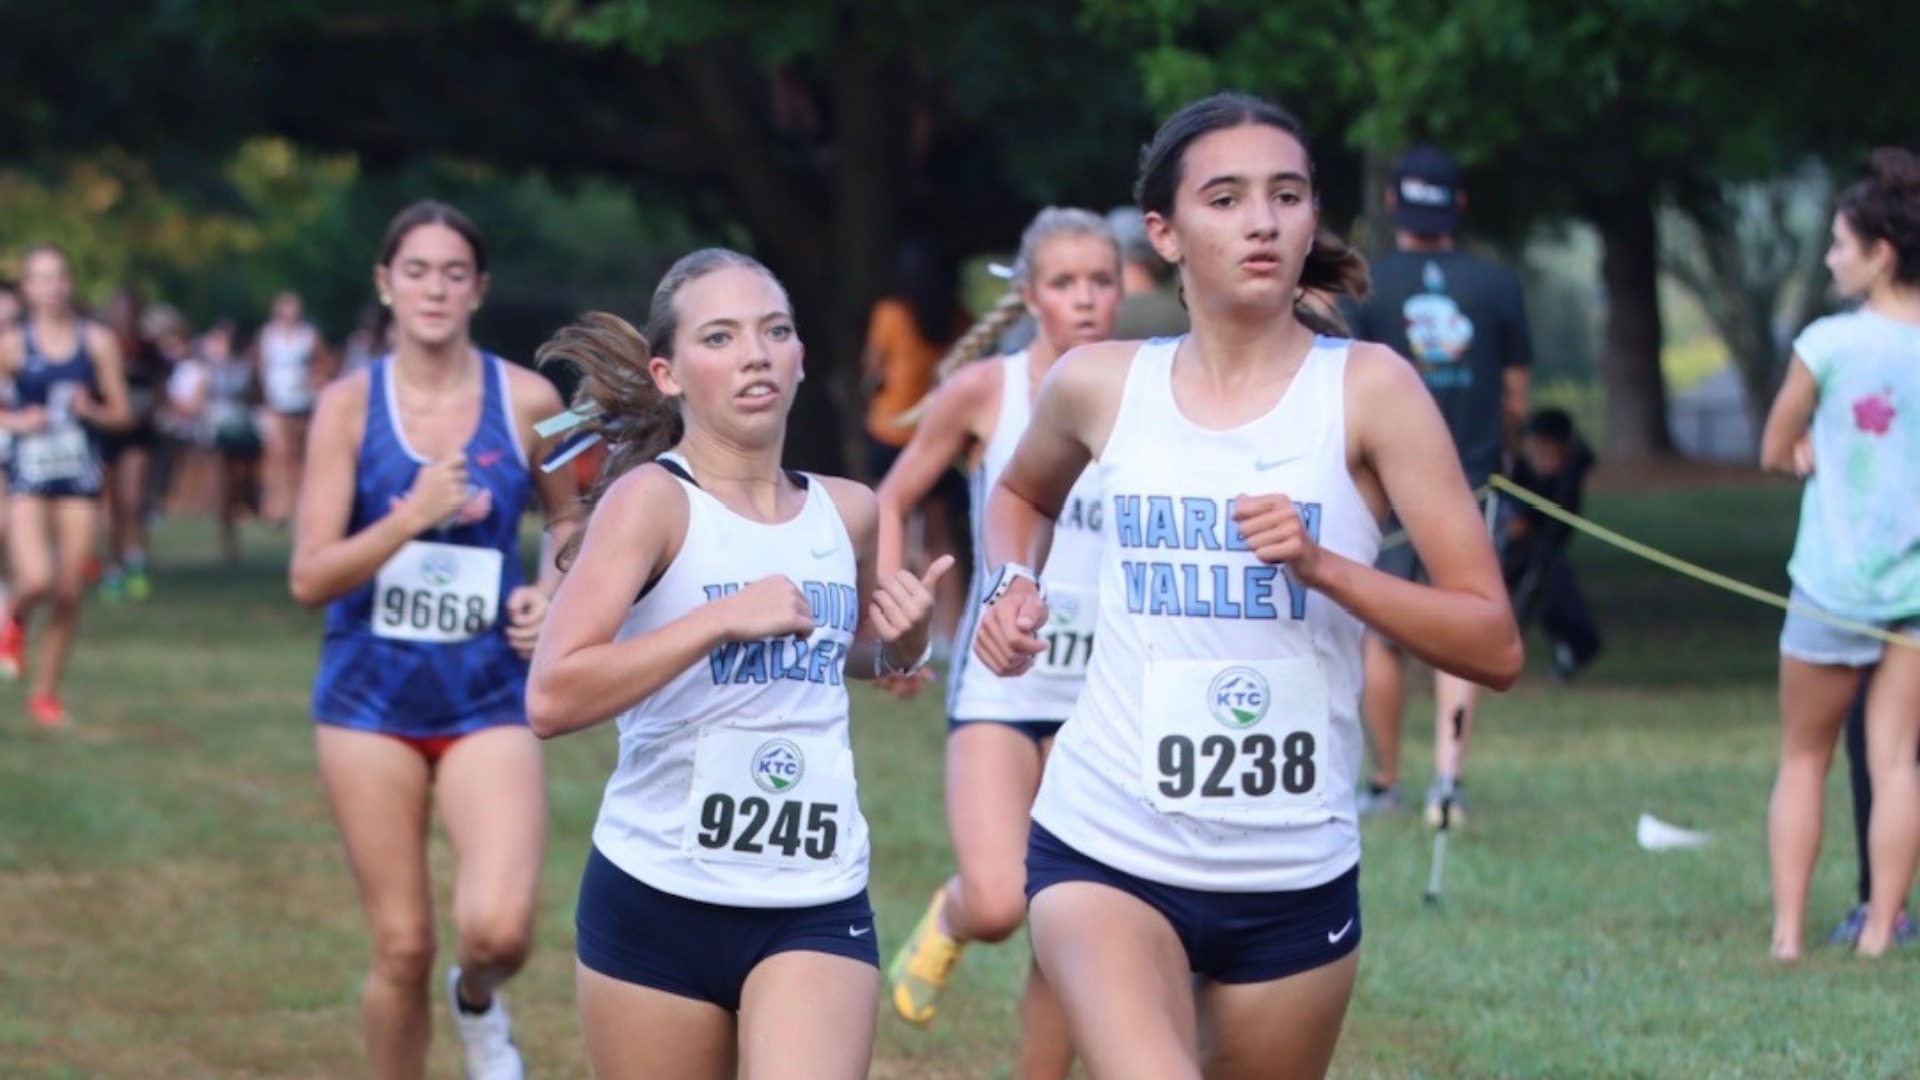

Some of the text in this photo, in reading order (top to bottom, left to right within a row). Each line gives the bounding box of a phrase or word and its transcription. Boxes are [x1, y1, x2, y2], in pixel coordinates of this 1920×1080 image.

[384, 587, 486, 635] 9668
[1122, 561, 1309, 621] VALLEY
[1217, 692, 1261, 707] KTC
[759, 760, 797, 775] KTC
[1158, 731, 1316, 799] 9238
[698, 792, 838, 861] 9245
